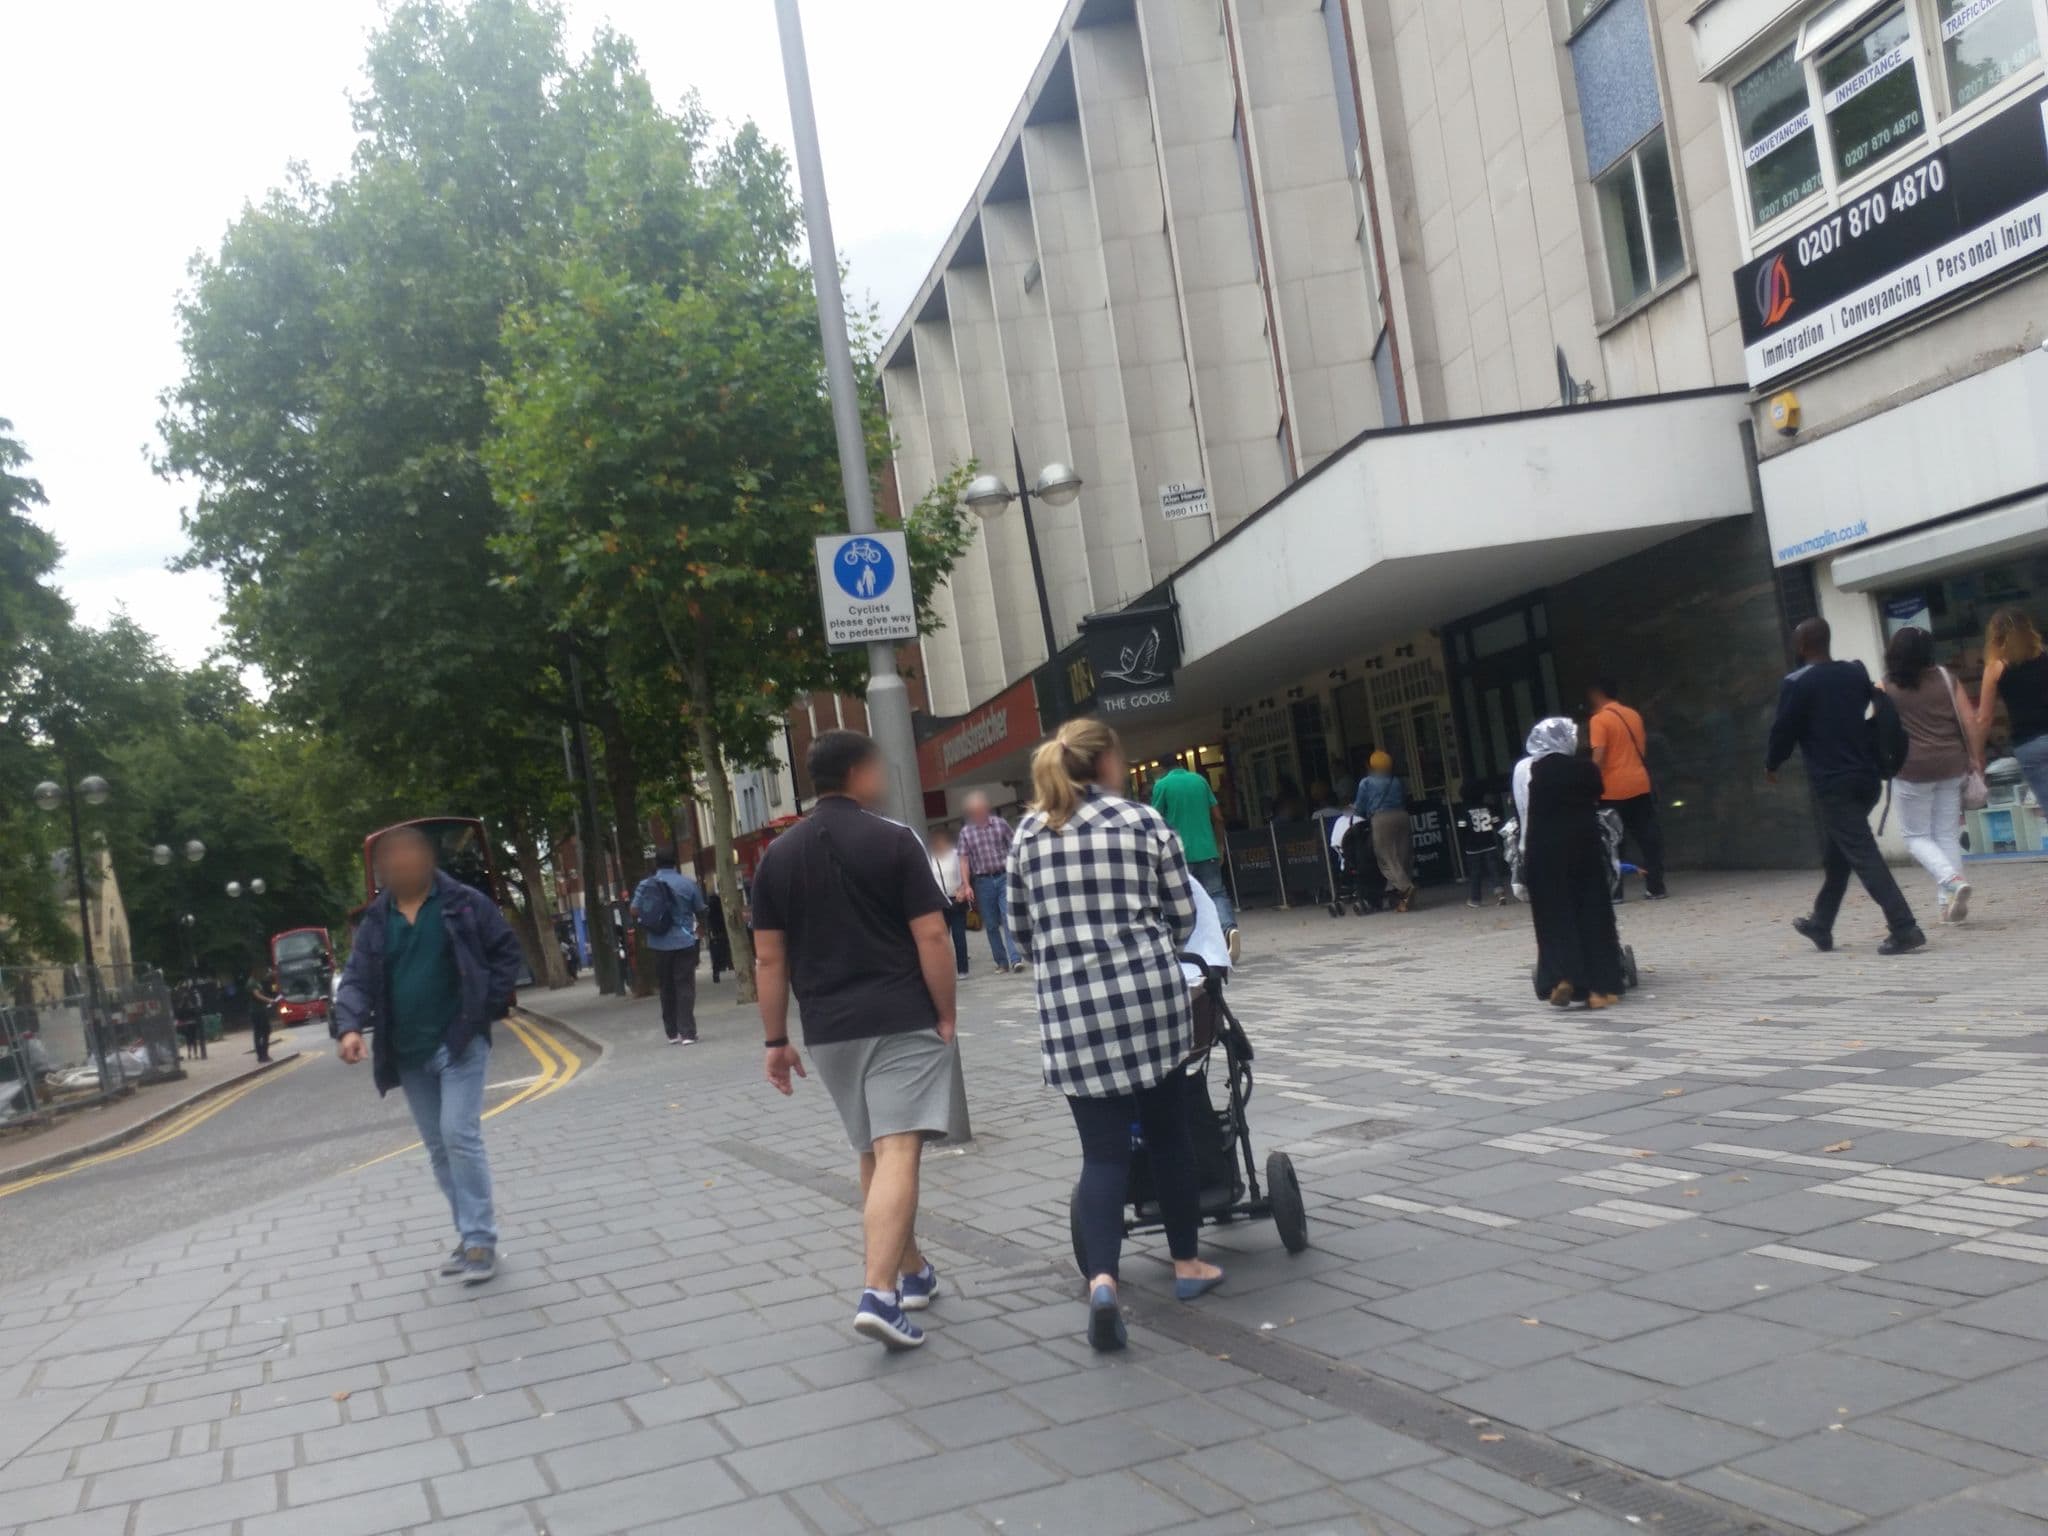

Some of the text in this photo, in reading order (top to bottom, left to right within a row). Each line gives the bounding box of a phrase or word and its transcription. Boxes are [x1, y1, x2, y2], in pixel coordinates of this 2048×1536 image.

[1946, 2, 1979, 35] TRAFFIC
[1835, 49, 1902, 103] INHERITANCE
[1749, 113, 1809, 161] CONVEYANCING
[1844, 110, 1919, 168] 0207 870 4870
[1759, 199, 1780, 222] 0207
[1782, 187, 1799, 208] 870
[1798, 159, 1944, 267] 0207 870 4870
[1761, 211, 2042, 369] Immigration Conveyancing Personal Injury
[1778, 519, 1868, 560] www.maplin.co.uk
[830, 614, 911, 629] please give way
[848, 603, 891, 617] Cyclists
[835, 625, 910, 640] to pedestrians
[1104, 690, 1171, 712] THE GOOSE
